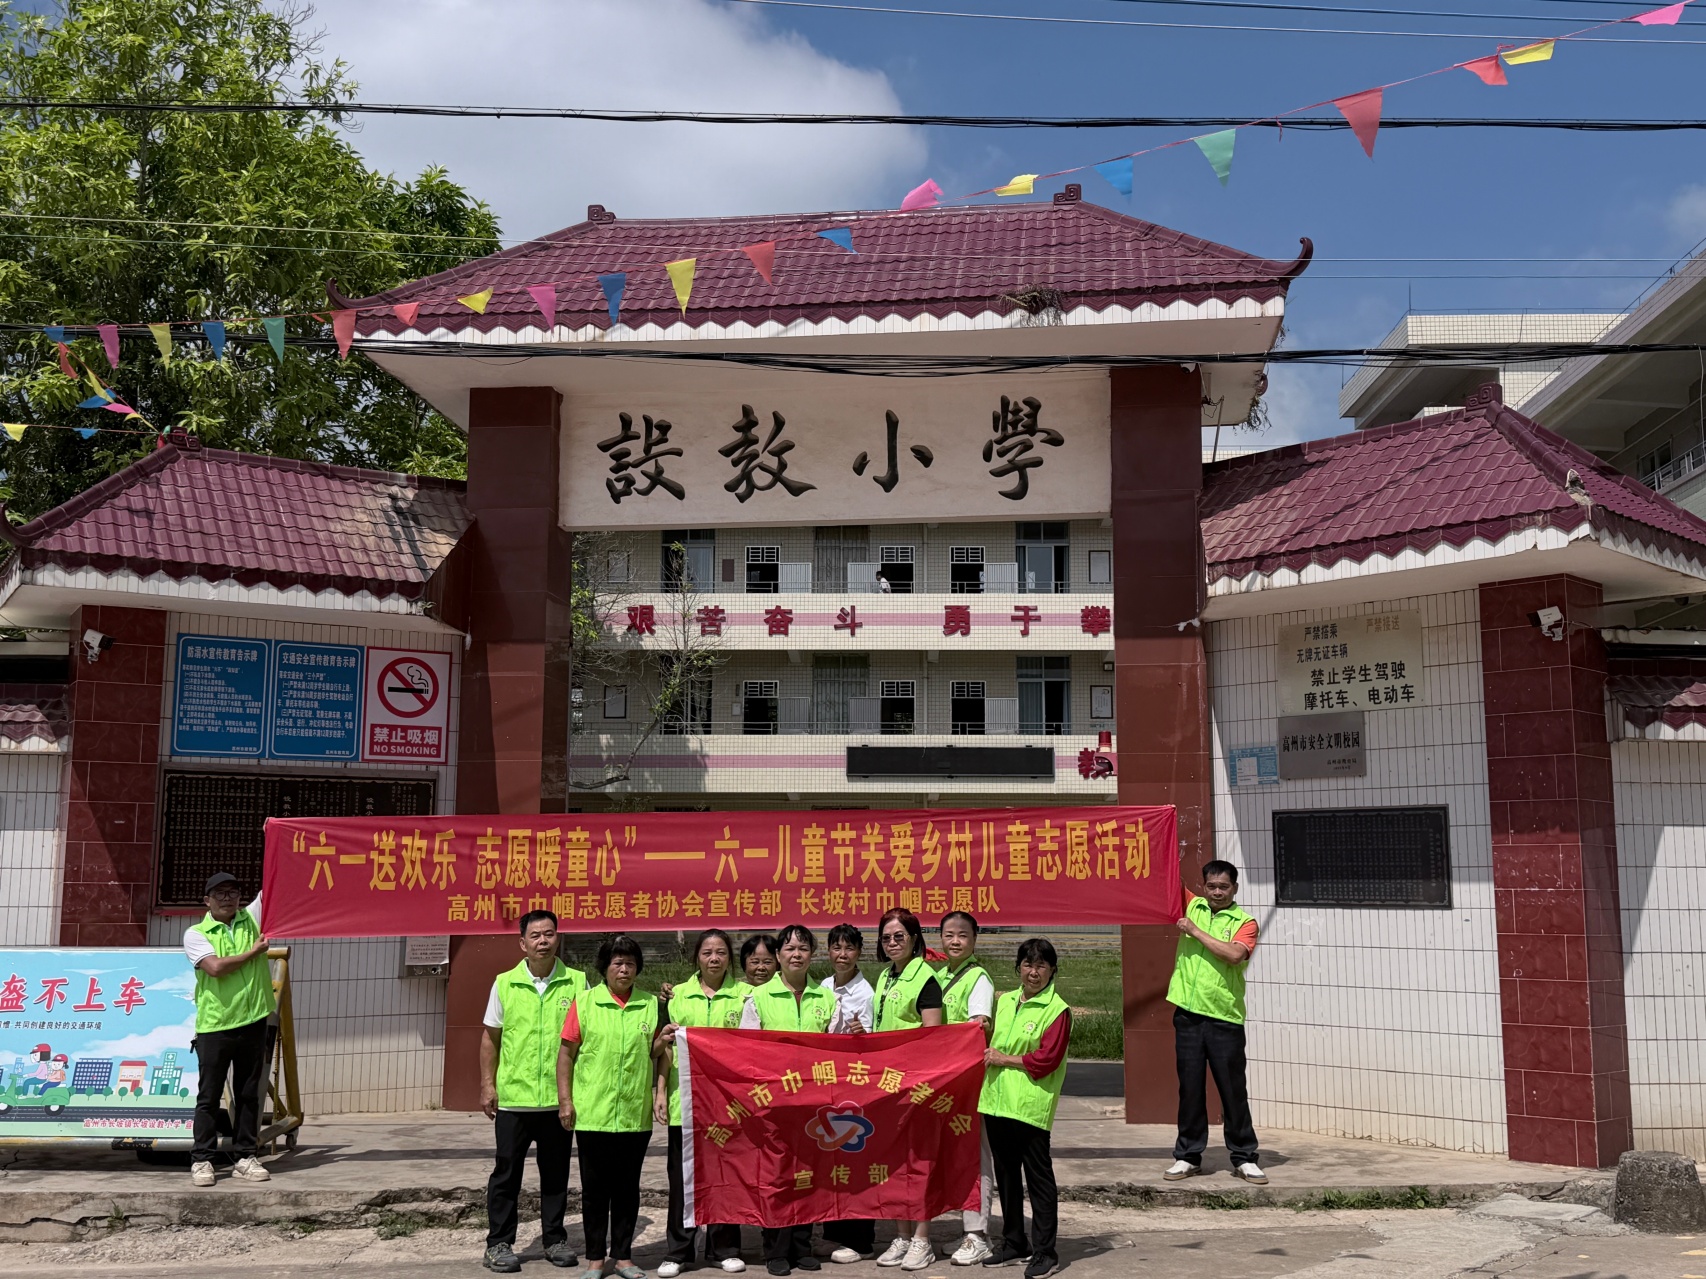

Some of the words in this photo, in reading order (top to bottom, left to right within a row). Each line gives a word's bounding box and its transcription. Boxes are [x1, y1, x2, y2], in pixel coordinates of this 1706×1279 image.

[626, 604, 863, 637] 艰苦奋斗
[1303, 623, 1338, 642] 严禁搭乘
[187, 646, 258, 662] 防溺水宣传教育告示牌
[282, 652, 356, 668] 交通安全宣传教育告示牌
[1296, 643, 1348, 663] 无牌无证车辆
[1310, 660, 1406, 687] 禁止学生驾驶
[1304, 684, 1415, 710] 摩托车、电动车
[373, 727, 439, 746] 禁止吸烟
[1282, 731, 1361, 752] 高州市安全文明校园
[373, 744, 388, 753] NO
[390, 745, 437, 756] SMOKING
[292, 827, 457, 891] “六一送欢乐
[447, 888, 782, 923] 高州市巾帼志愿者协会宣传部
[796, 885, 1000, 917] 长坡村巾帼志愿队
[0, 973, 147, 1015] 盔不上车
[14, 1021, 102, 1030] 共同创建良好的交通环境
[704, 1060, 973, 1148] 高州市巾帼志愿者协会
[83, 1118, 182, 1129] 高州市长坡镇长坡设教小学
[793, 1163, 889, 1191] 宣传部
